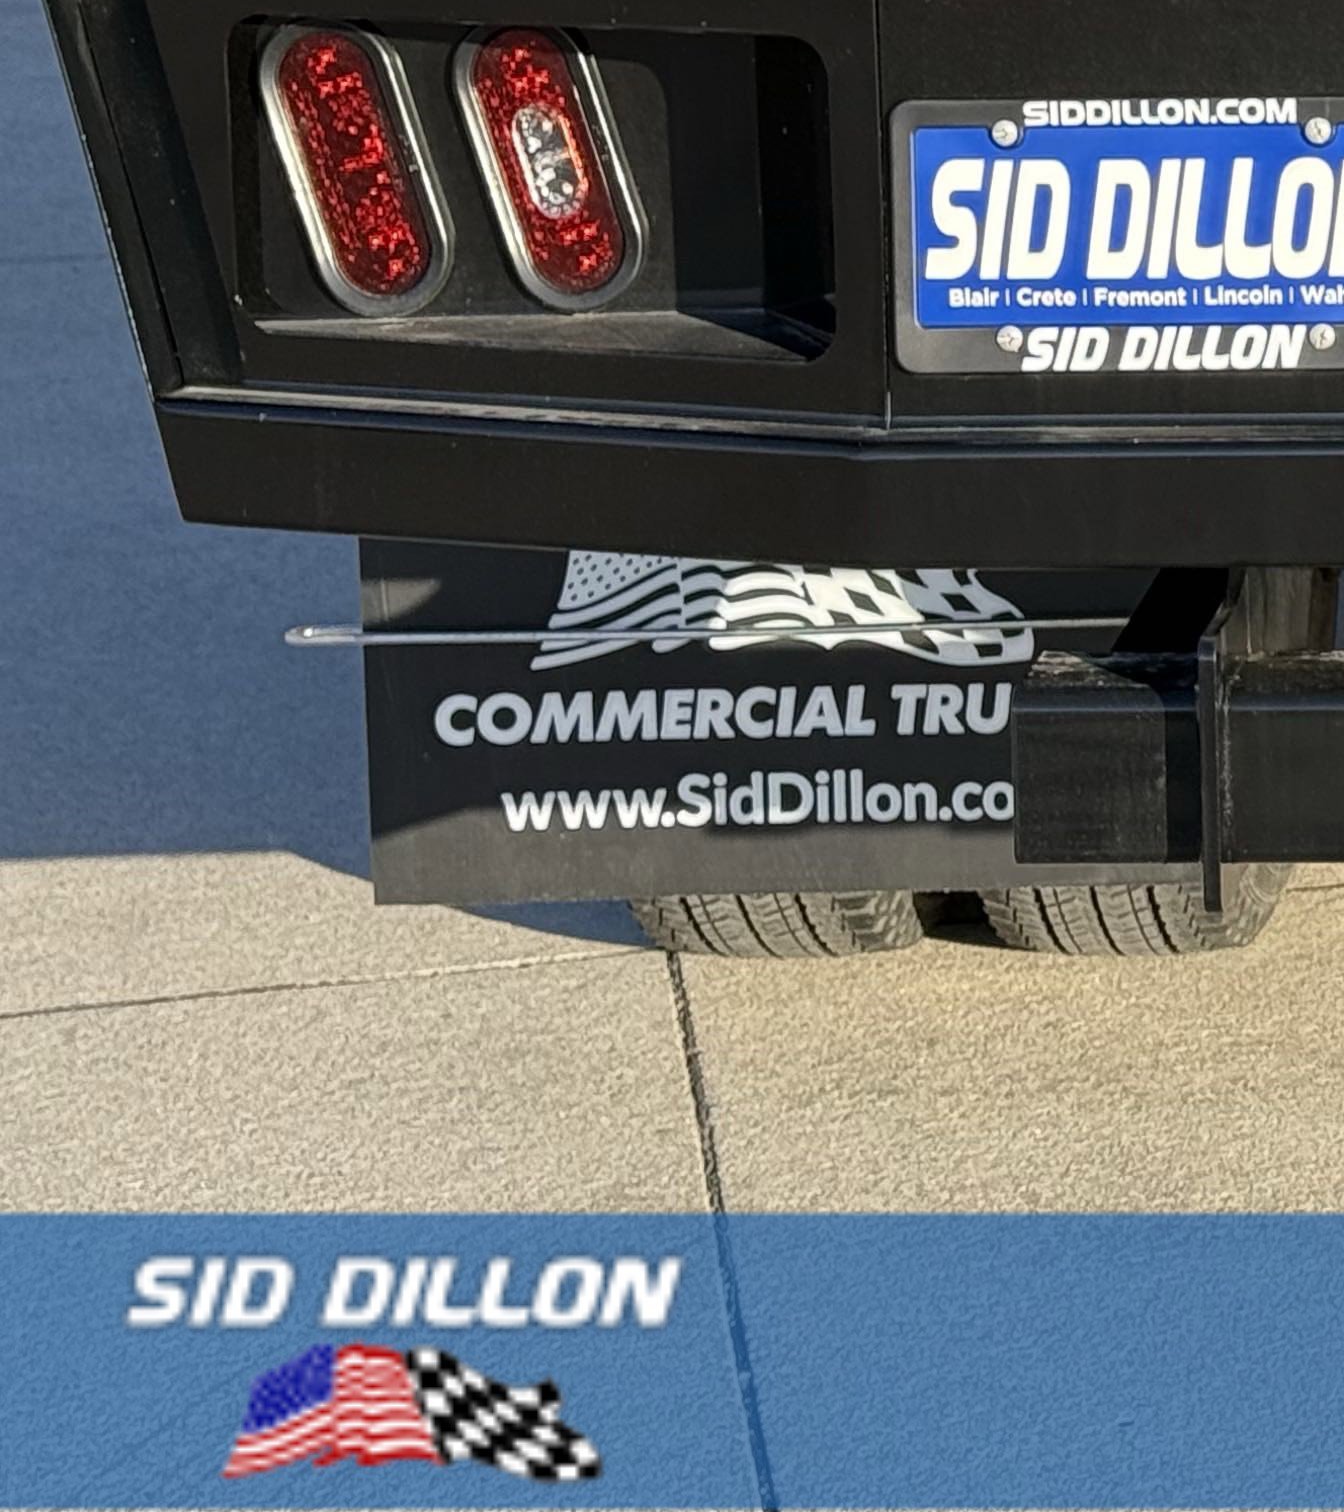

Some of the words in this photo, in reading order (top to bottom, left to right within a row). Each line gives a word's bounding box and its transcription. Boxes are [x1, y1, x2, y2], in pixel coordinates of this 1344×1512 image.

[1022, 97, 1298, 127] SIDDILLON.COM
[925, 159, 1071, 280] SID
[949, 287, 1000, 308] Blair
[1016, 287, 1077, 308] Crete
[1093, 287, 1187, 308] Fremont
[1204, 285, 1283, 307] Lincoln
[1021, 326, 1110, 372] SID
[1117, 324, 1307, 372] DILLON
[433, 685, 877, 747] COMMERCIAL
[890, 682, 1013, 736] TRU
[500, 768, 1016, 833] www.SidDillon.co
